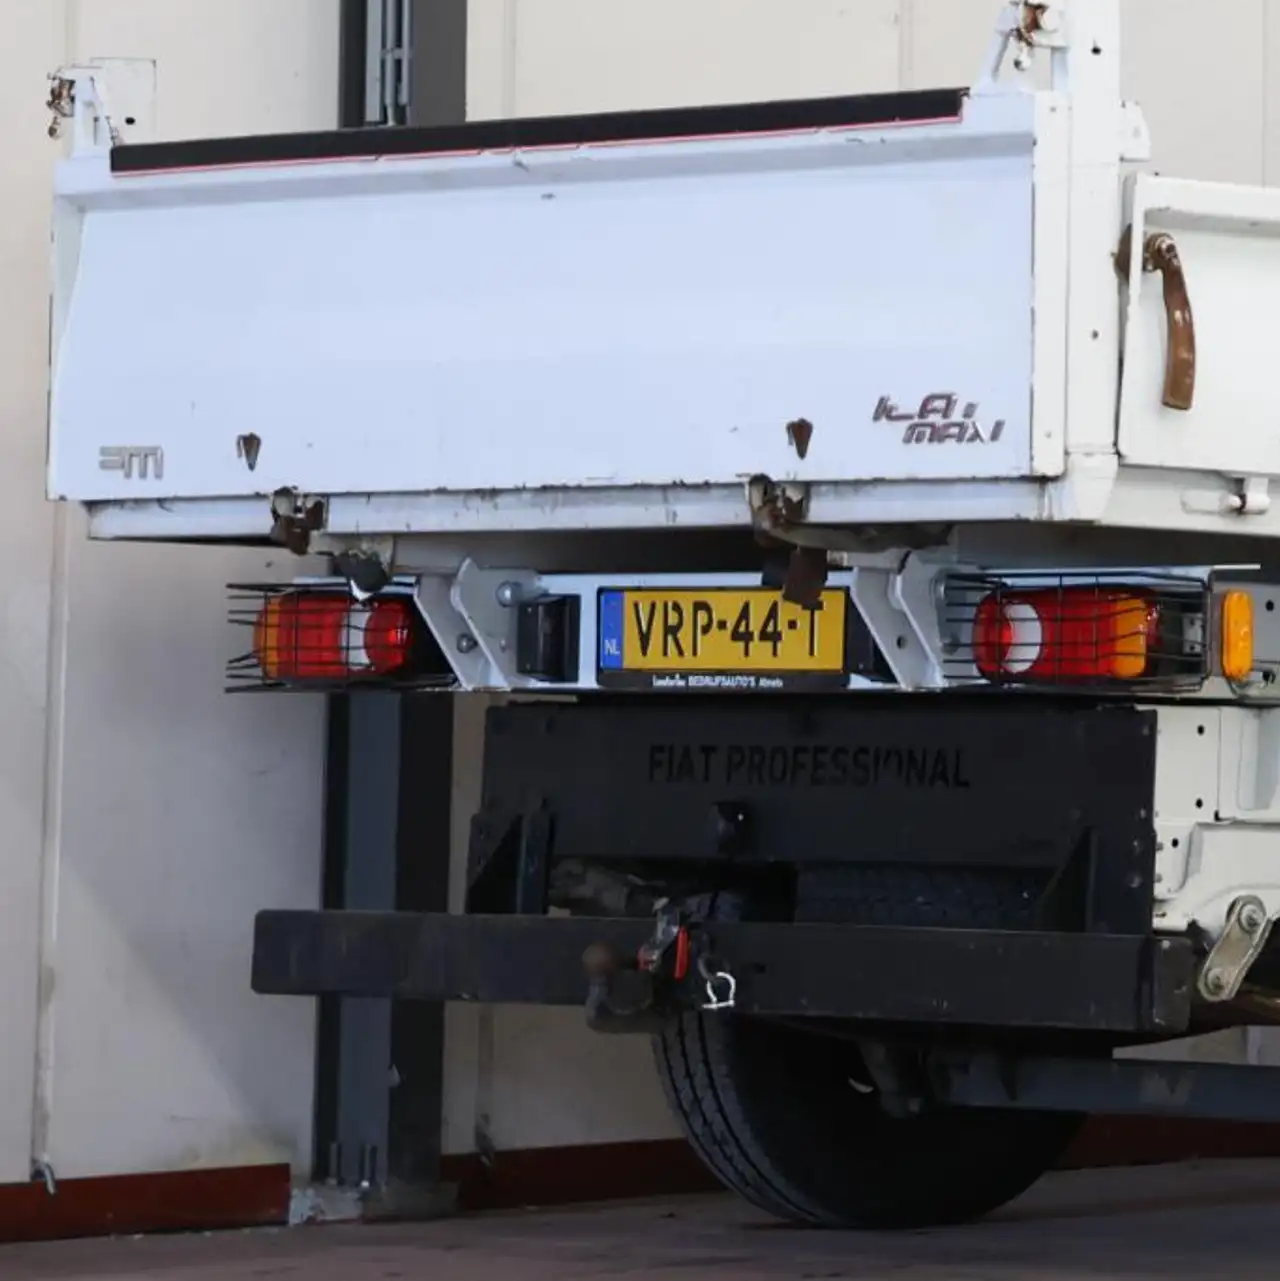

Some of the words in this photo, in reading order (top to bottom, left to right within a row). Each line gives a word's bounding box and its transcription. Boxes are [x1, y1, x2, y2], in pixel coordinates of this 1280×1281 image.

[604, 638, 621, 656] NL
[633, 599, 826, 658] VRP-44-T
[648, 743, 718, 784] FIAT
[726, 744, 971, 789] PROFESSIONAL
